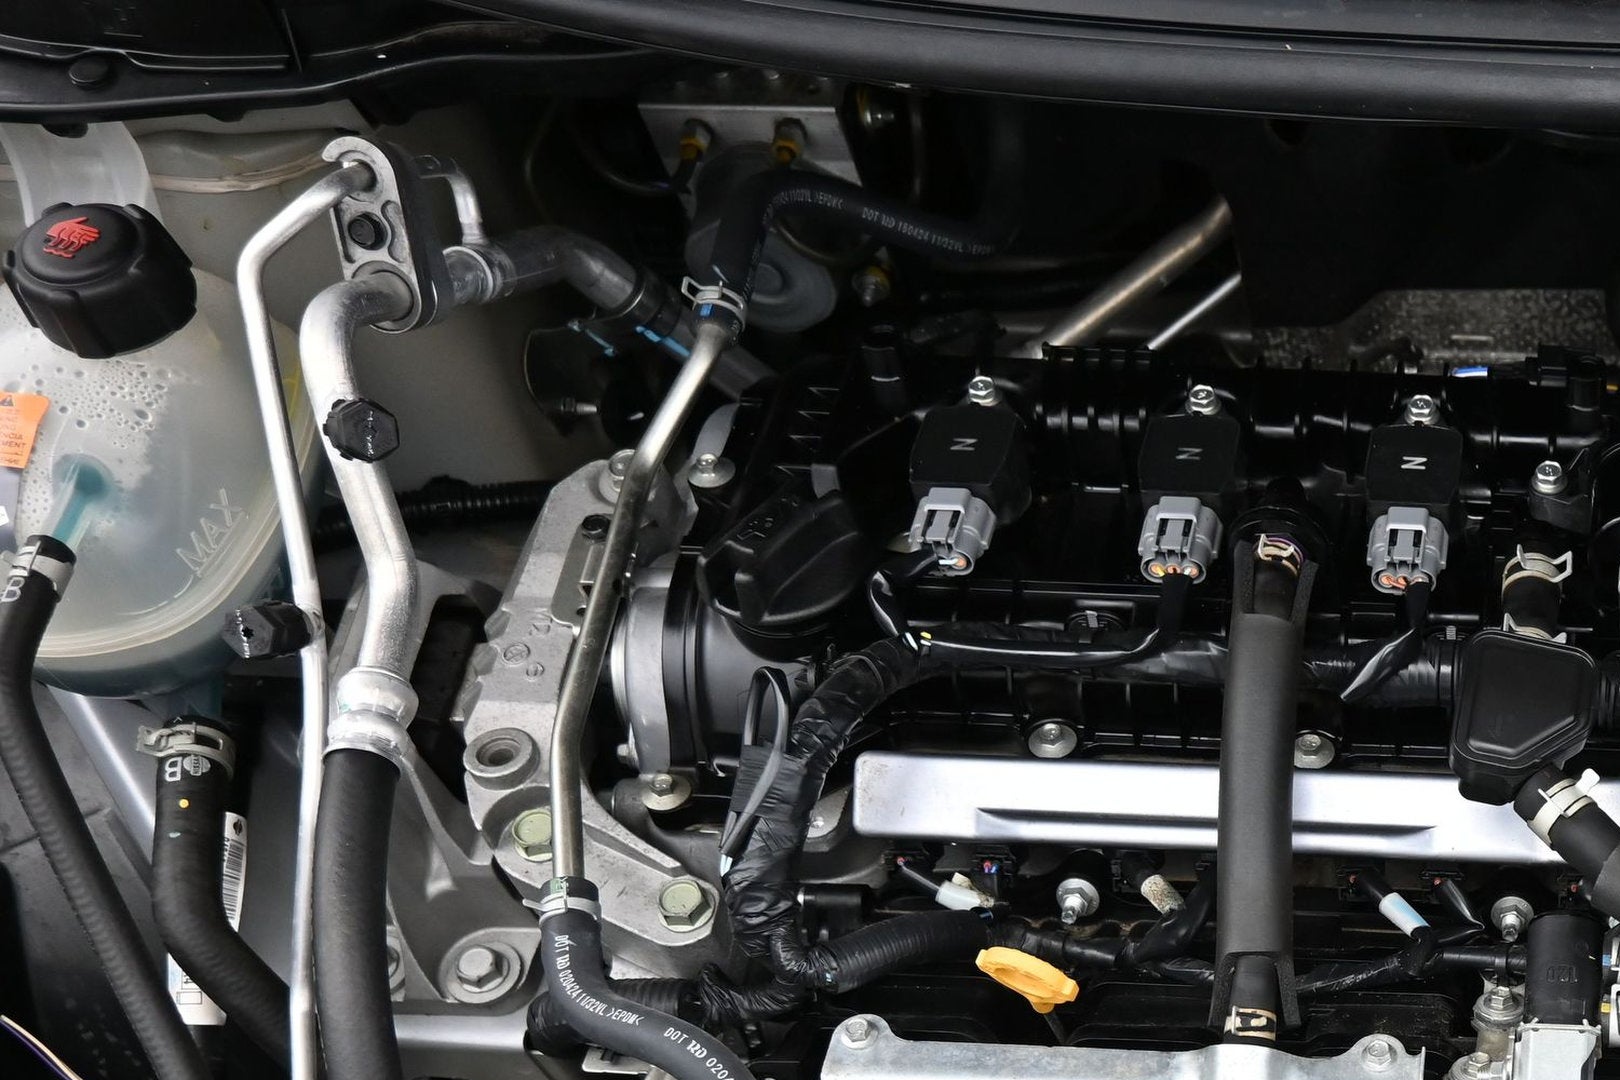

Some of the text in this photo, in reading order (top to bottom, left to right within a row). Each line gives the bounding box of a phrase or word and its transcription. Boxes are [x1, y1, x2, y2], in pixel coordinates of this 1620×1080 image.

[174, 487, 243, 578] MAX
[554, 934, 570, 953] DOT
[558, 969, 584, 999] 020424
[663, 1027, 689, 1045] DOT
